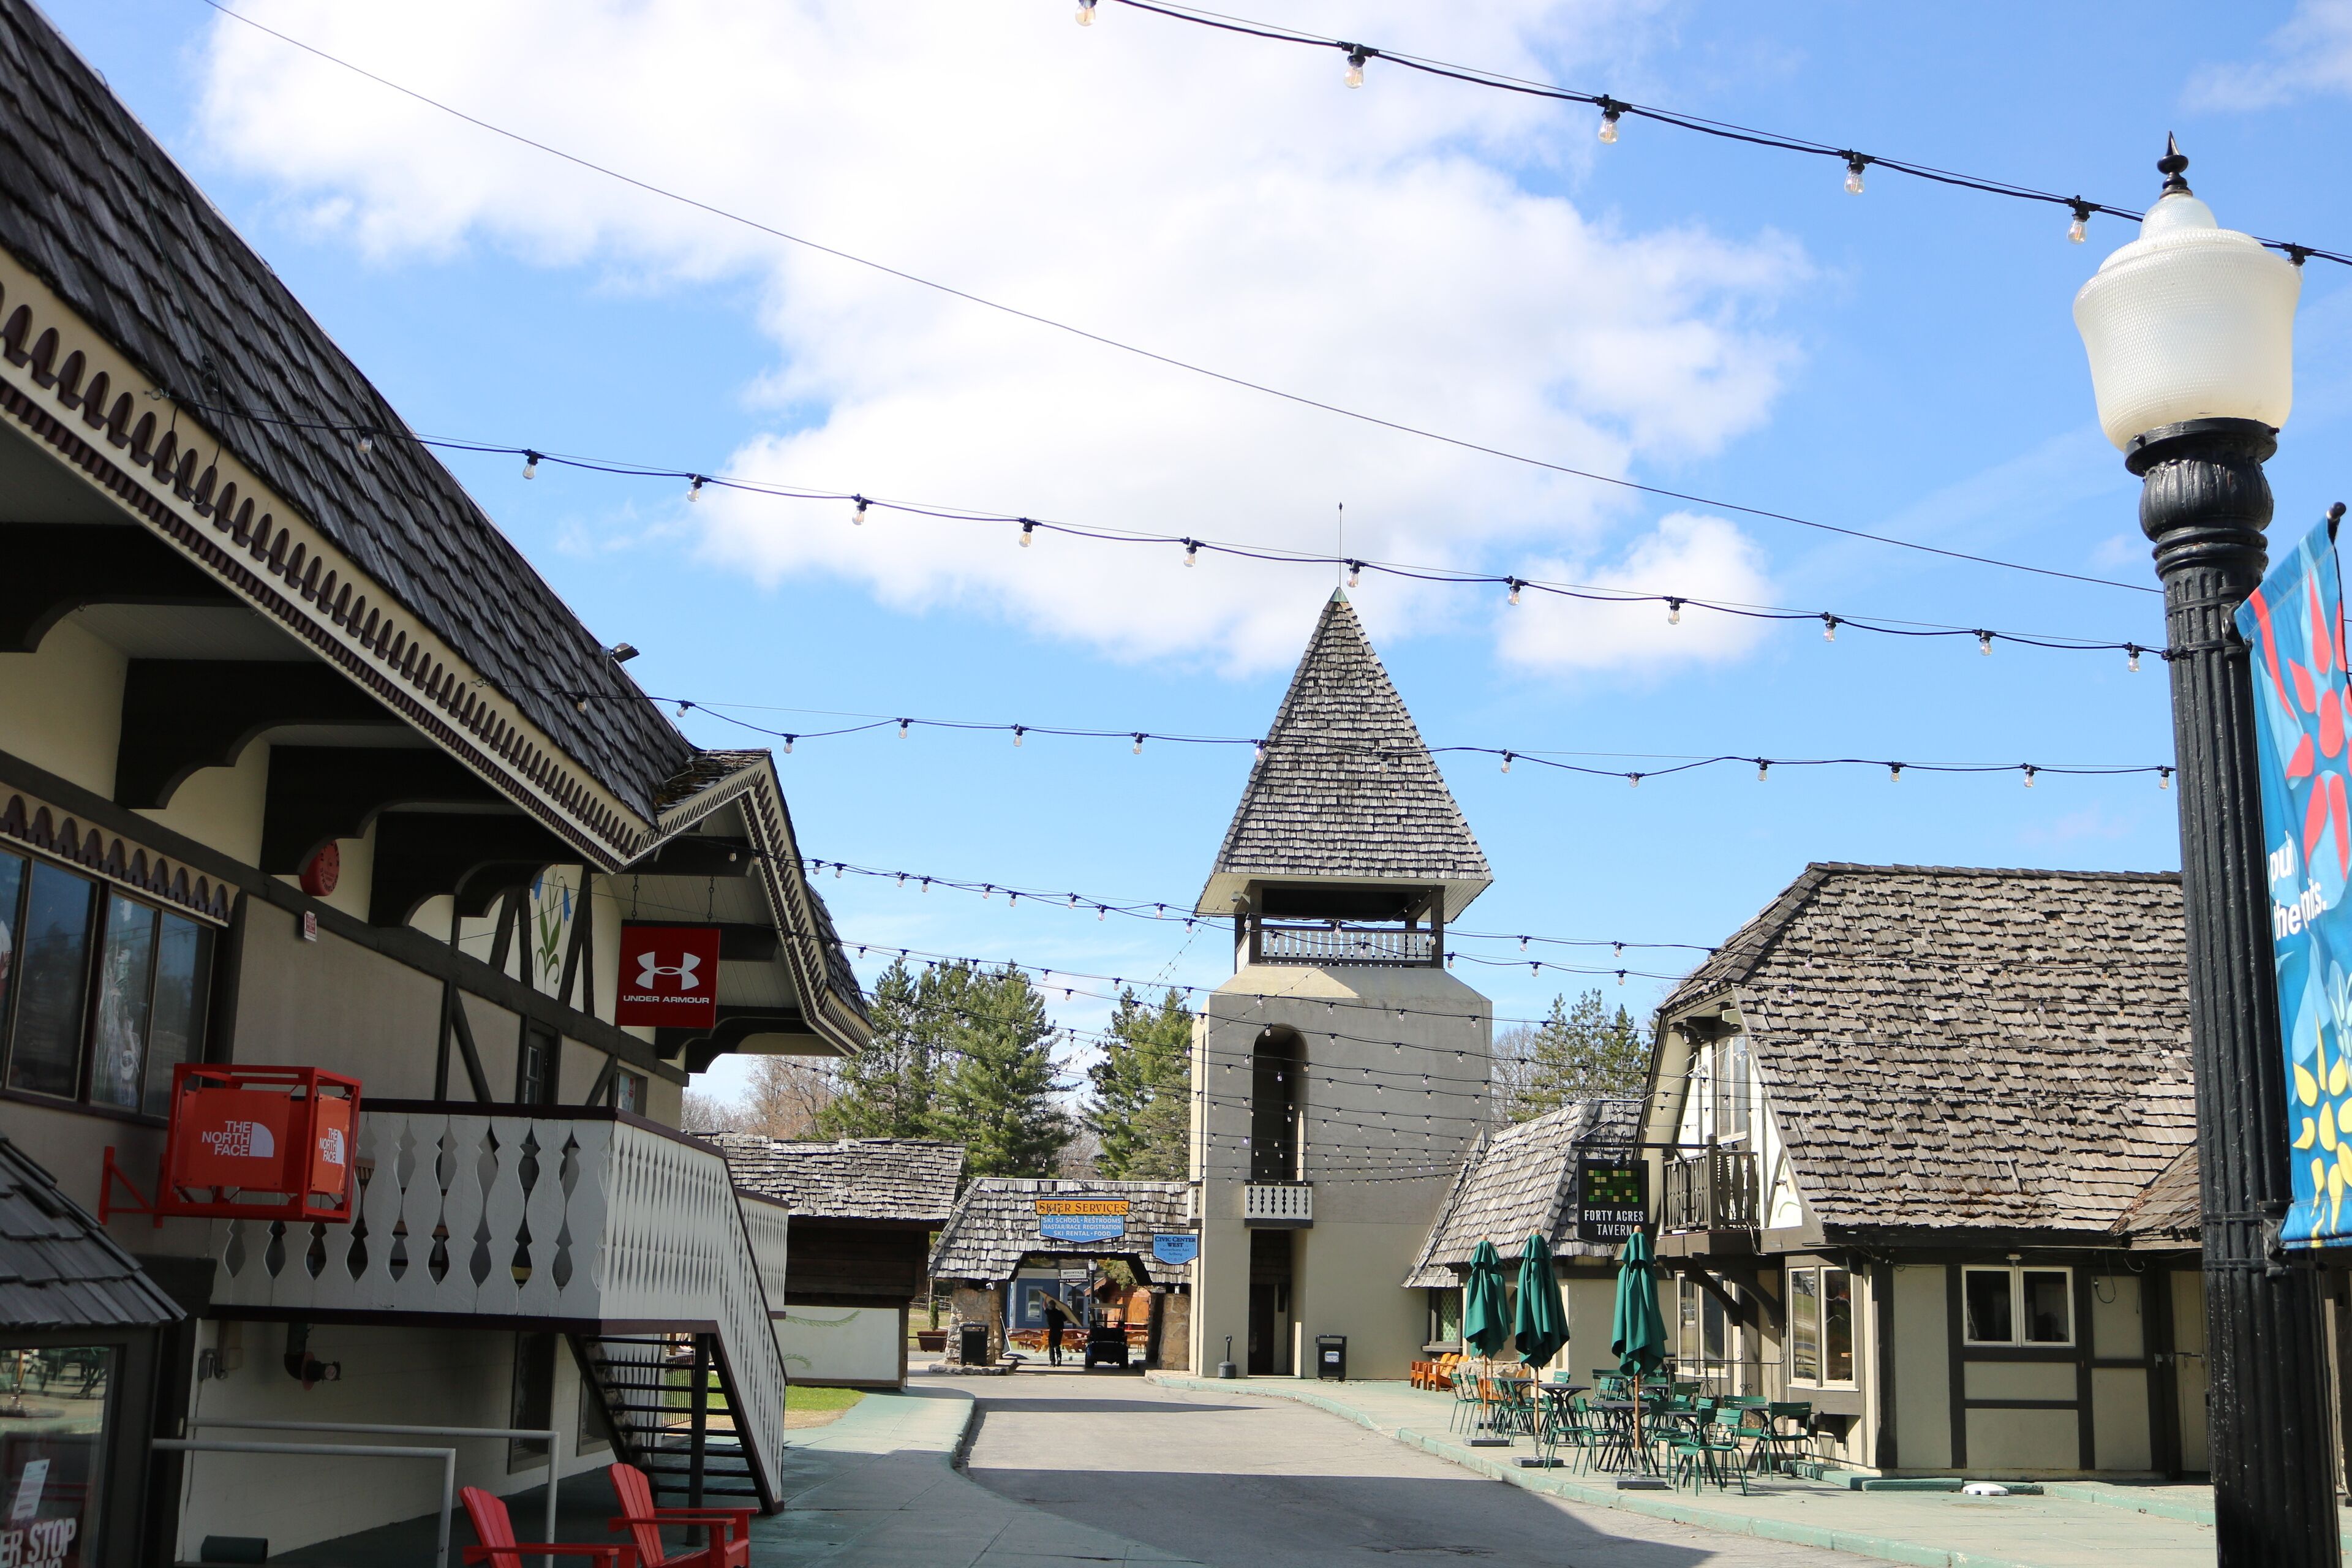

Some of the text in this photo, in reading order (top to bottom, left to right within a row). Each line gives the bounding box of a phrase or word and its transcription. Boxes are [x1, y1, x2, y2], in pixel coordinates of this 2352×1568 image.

[225, 1120, 252, 1133] THE
[202, 1131, 251, 1145] NORTH
[328, 1128, 338, 1140] THE
[214, 1144, 249, 1156] FACE
[319, 1137, 337, 1152] NORTH
[323, 1150, 336, 1163] FACE
[1039, 1202, 1126, 1212] SKIER SERVICES
[1584, 1210, 1643, 1222] FORTY ACRES
[1596, 1224, 1632, 1236] TAVERN
[28, 1517, 77, 1562] STOP
